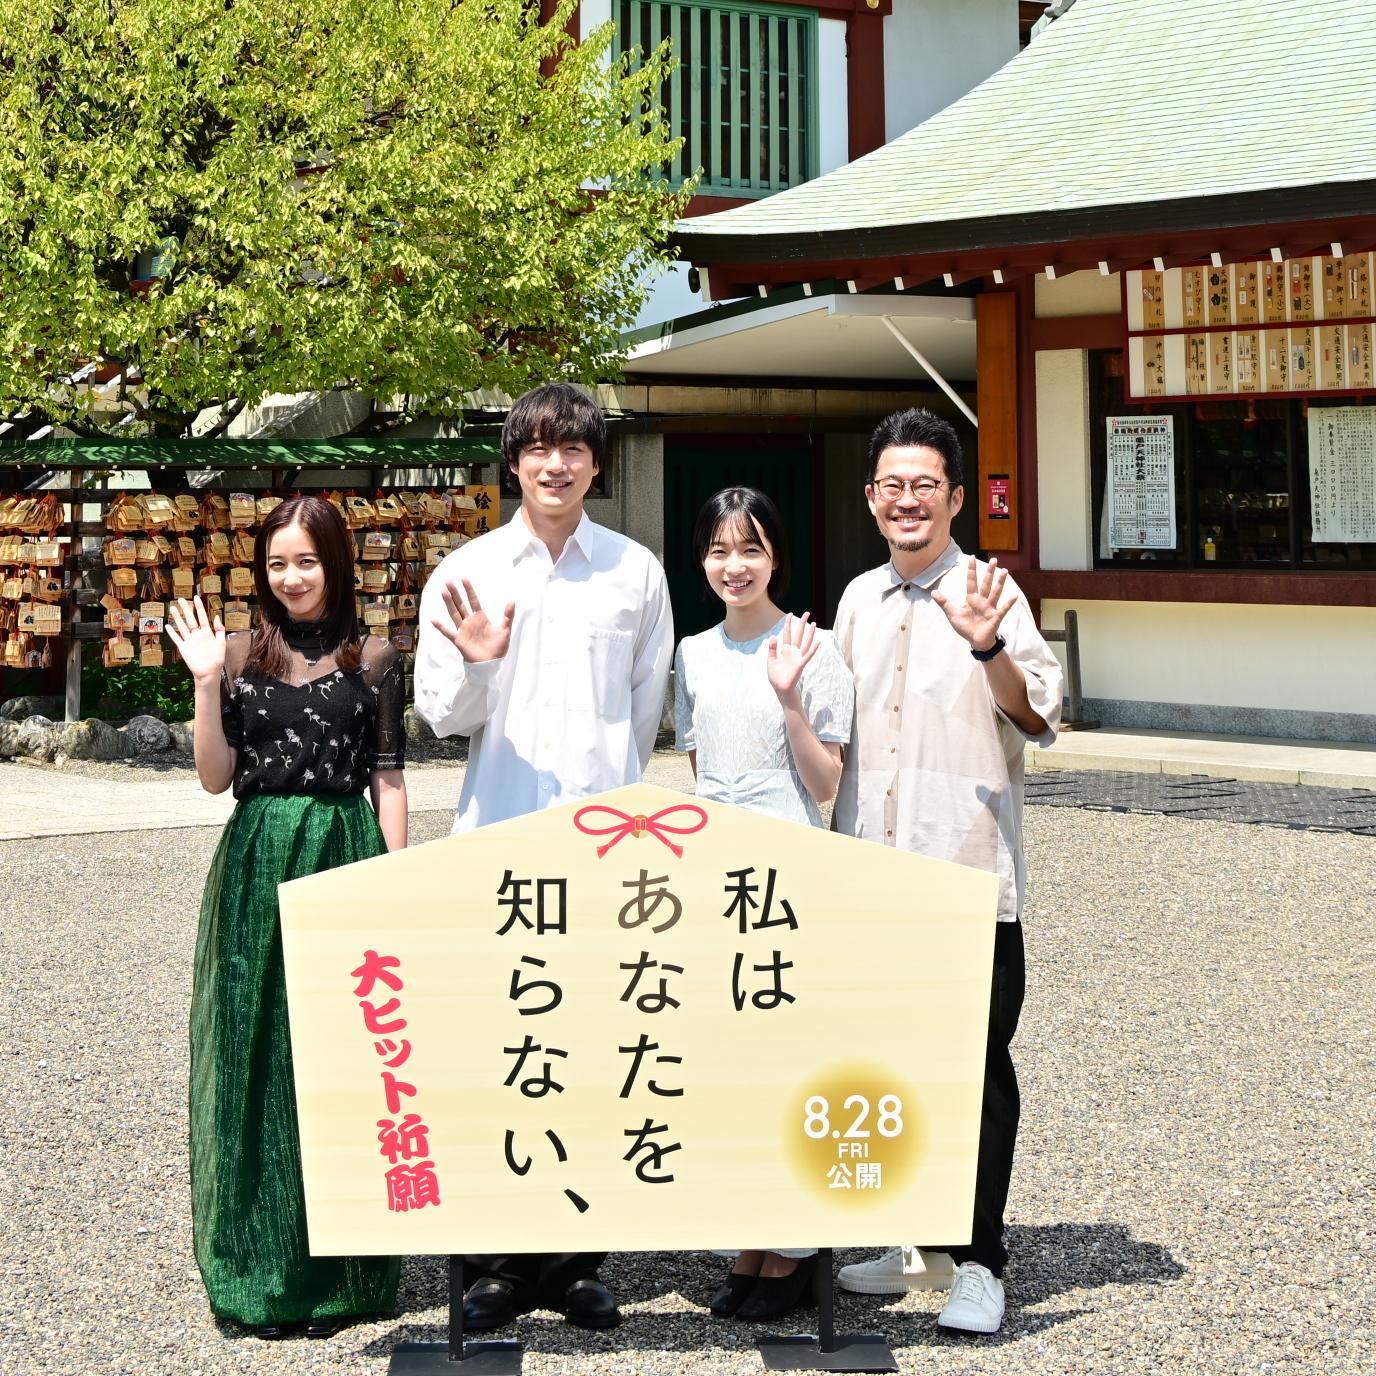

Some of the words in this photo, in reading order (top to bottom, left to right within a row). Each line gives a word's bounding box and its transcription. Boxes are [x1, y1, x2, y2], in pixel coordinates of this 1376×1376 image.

[474, 492, 492, 535] 絵馬
[724, 866, 800, 1013] 私は
[496, 869, 591, 1215] 知らない、
[617, 869, 686, 1185] あなたを
[351, 950, 442, 1214] 大ヒット祈願
[804, 1094, 903, 1139] 8.28
[826, 1162, 882, 1189] 公開
[838, 1142, 868, 1158] FRI
